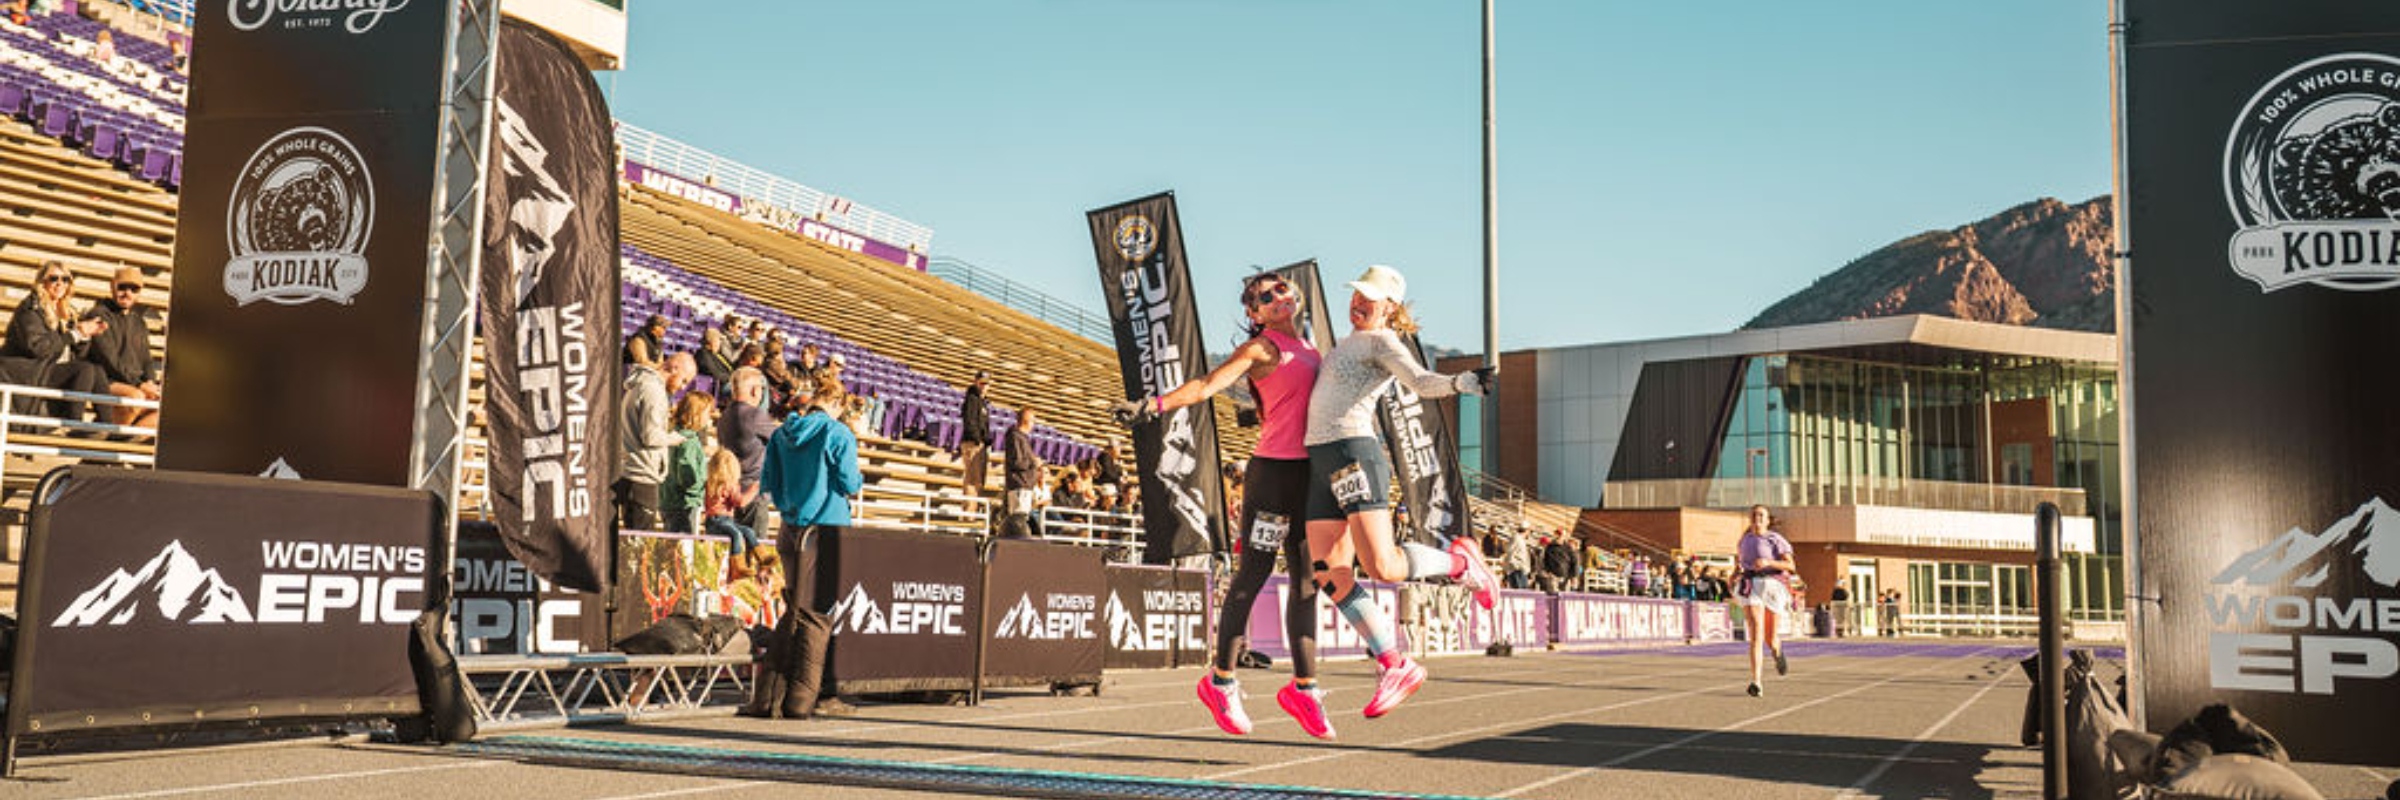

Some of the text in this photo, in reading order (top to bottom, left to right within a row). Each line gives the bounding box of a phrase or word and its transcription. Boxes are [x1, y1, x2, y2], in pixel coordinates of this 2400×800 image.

[2259, 88, 2299, 124] 100%
[2299, 68, 2376, 95] WHOLE
[275, 137, 318, 156] WHOLE
[318, 140, 356, 177] GRAINS
[250, 258, 341, 292] KODIAK
[1138, 260, 1185, 398] EPIC
[515, 306, 566, 522] EPIC
[559, 301, 591, 518] WOMEN'S
[261, 540, 426, 573] WOMEN'S
[257, 573, 425, 624] EPIC
[891, 581, 965, 603] WOMEN'S
[1046, 592, 1096, 610] WOMEN'S
[1142, 589, 1203, 613] WOMEN'S
[449, 598, 582, 653] PIC
[889, 602, 964, 635] EPIC
[1045, 611, 1096, 639] EPIC
[1144, 614, 1205, 650] EPIC
